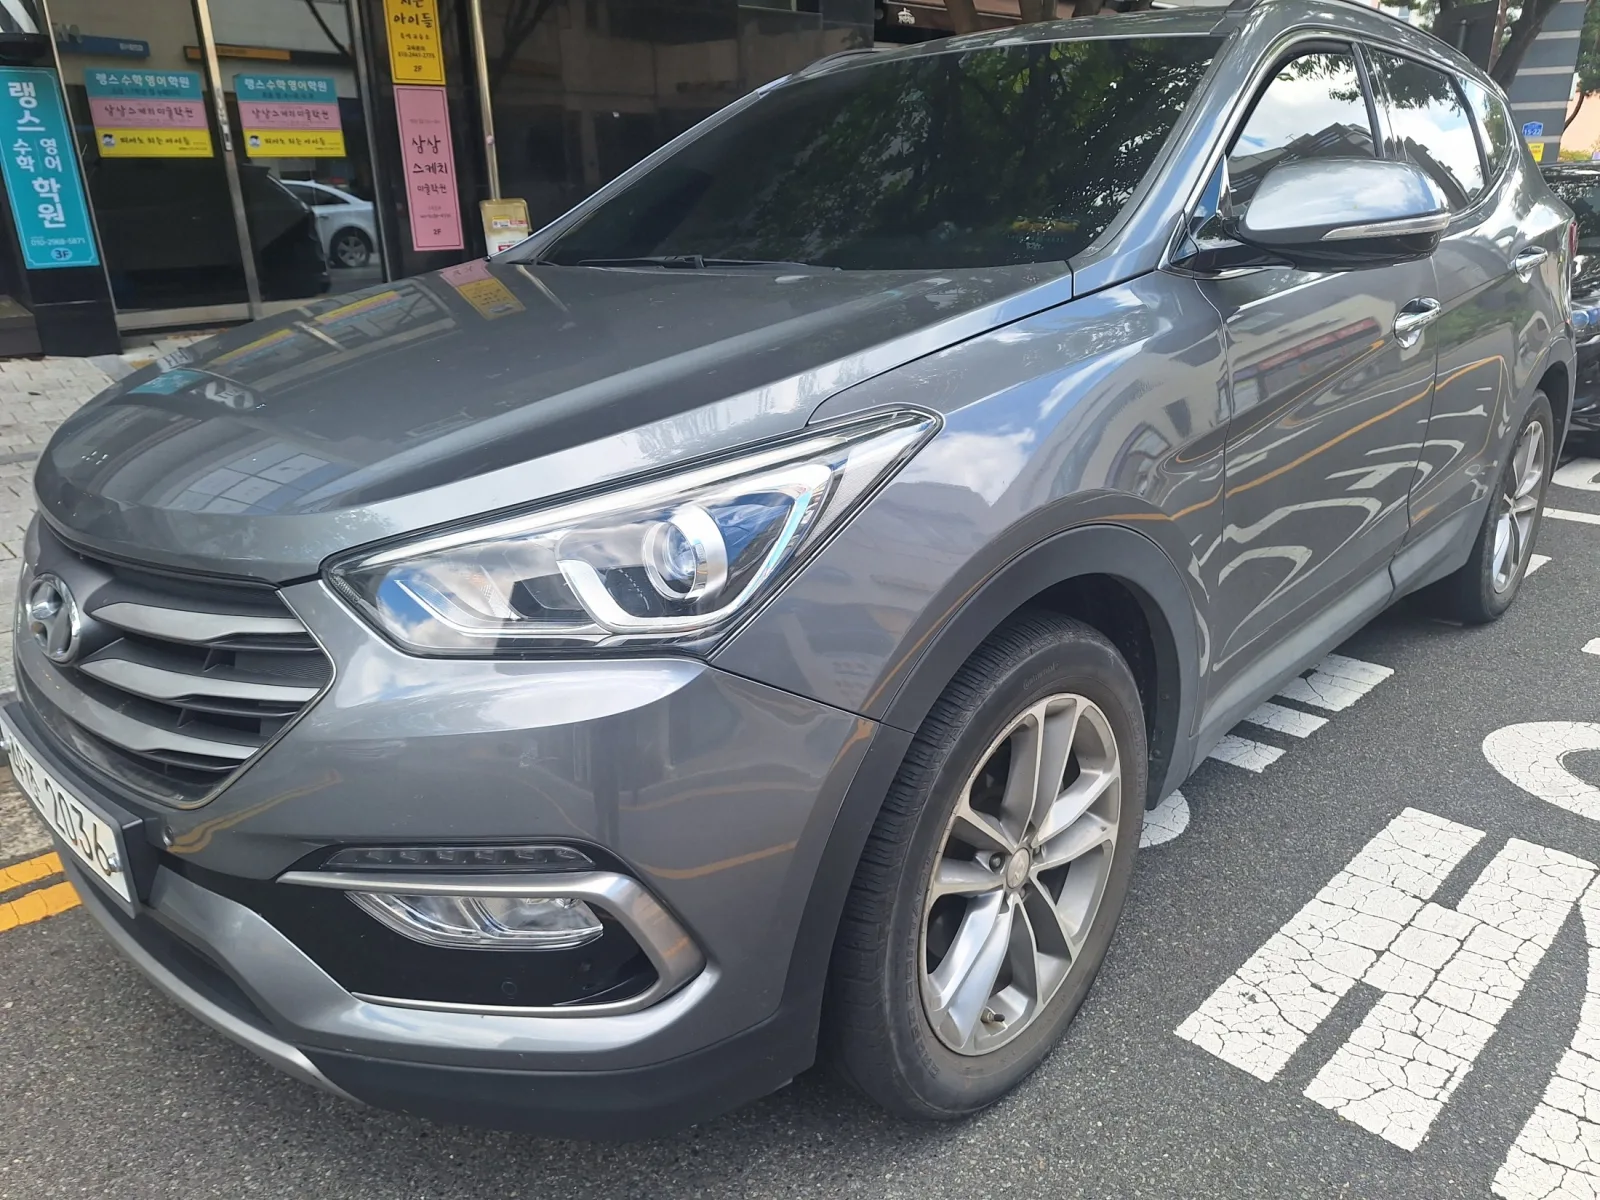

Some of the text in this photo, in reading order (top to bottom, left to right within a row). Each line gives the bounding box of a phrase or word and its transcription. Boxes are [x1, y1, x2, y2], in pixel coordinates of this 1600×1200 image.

[394, 12, 433, 28] 아이들
[413, 65, 423, 73] 2F
[412, 134, 442, 155] 상상
[413, 162, 448, 175] 스케치
[417, 183, 447, 196] 미술학원
[54, 249, 69, 259] 3F
[44, 777, 113, 877] 2036
